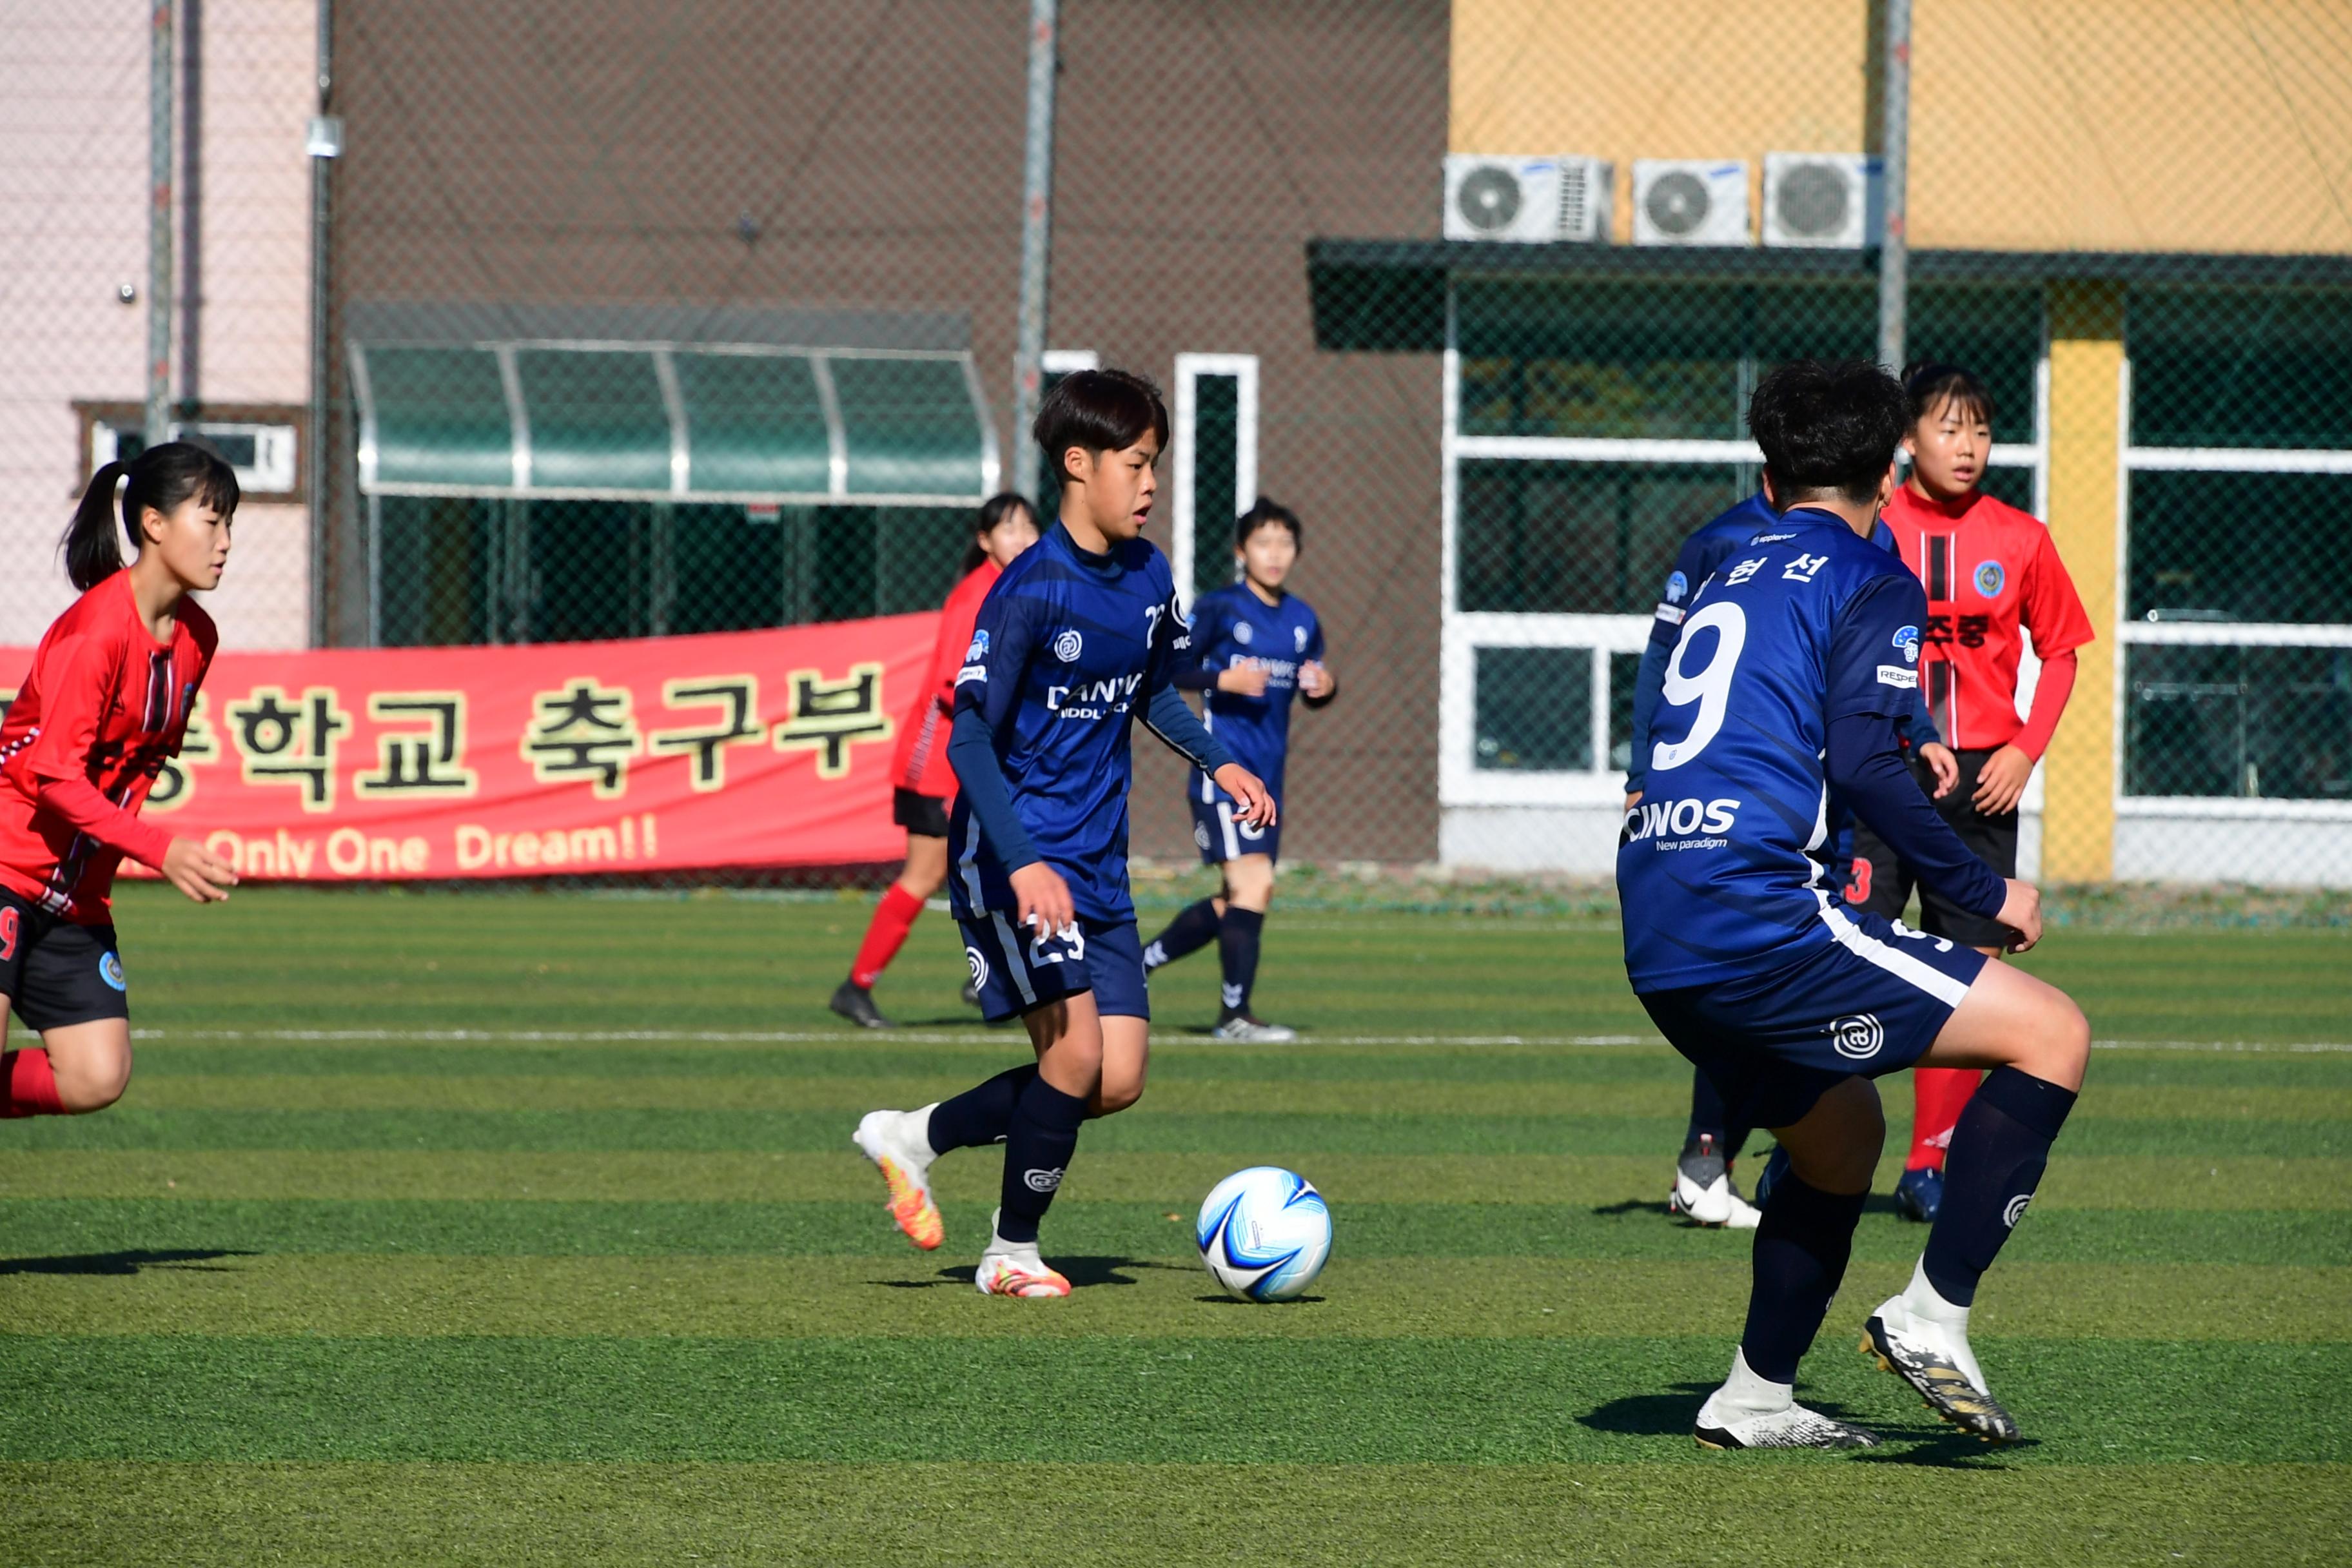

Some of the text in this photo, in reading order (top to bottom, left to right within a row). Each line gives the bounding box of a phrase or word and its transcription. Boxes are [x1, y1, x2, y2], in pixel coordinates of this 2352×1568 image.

[1652, 601, 1746, 771] 9
[1880, 670, 1918, 683] RESPE
[521, 662, 894, 799] 축구부
[205, 828, 315, 878] Only
[326, 828, 428, 874] One
[455, 813, 658, 870] Dream!!
[1656, 837, 1727, 852] New paradigm
[1845, 858, 1872, 905] 3
[0, 906, 19, 962] 9
[1017, 913, 1084, 968] 29
